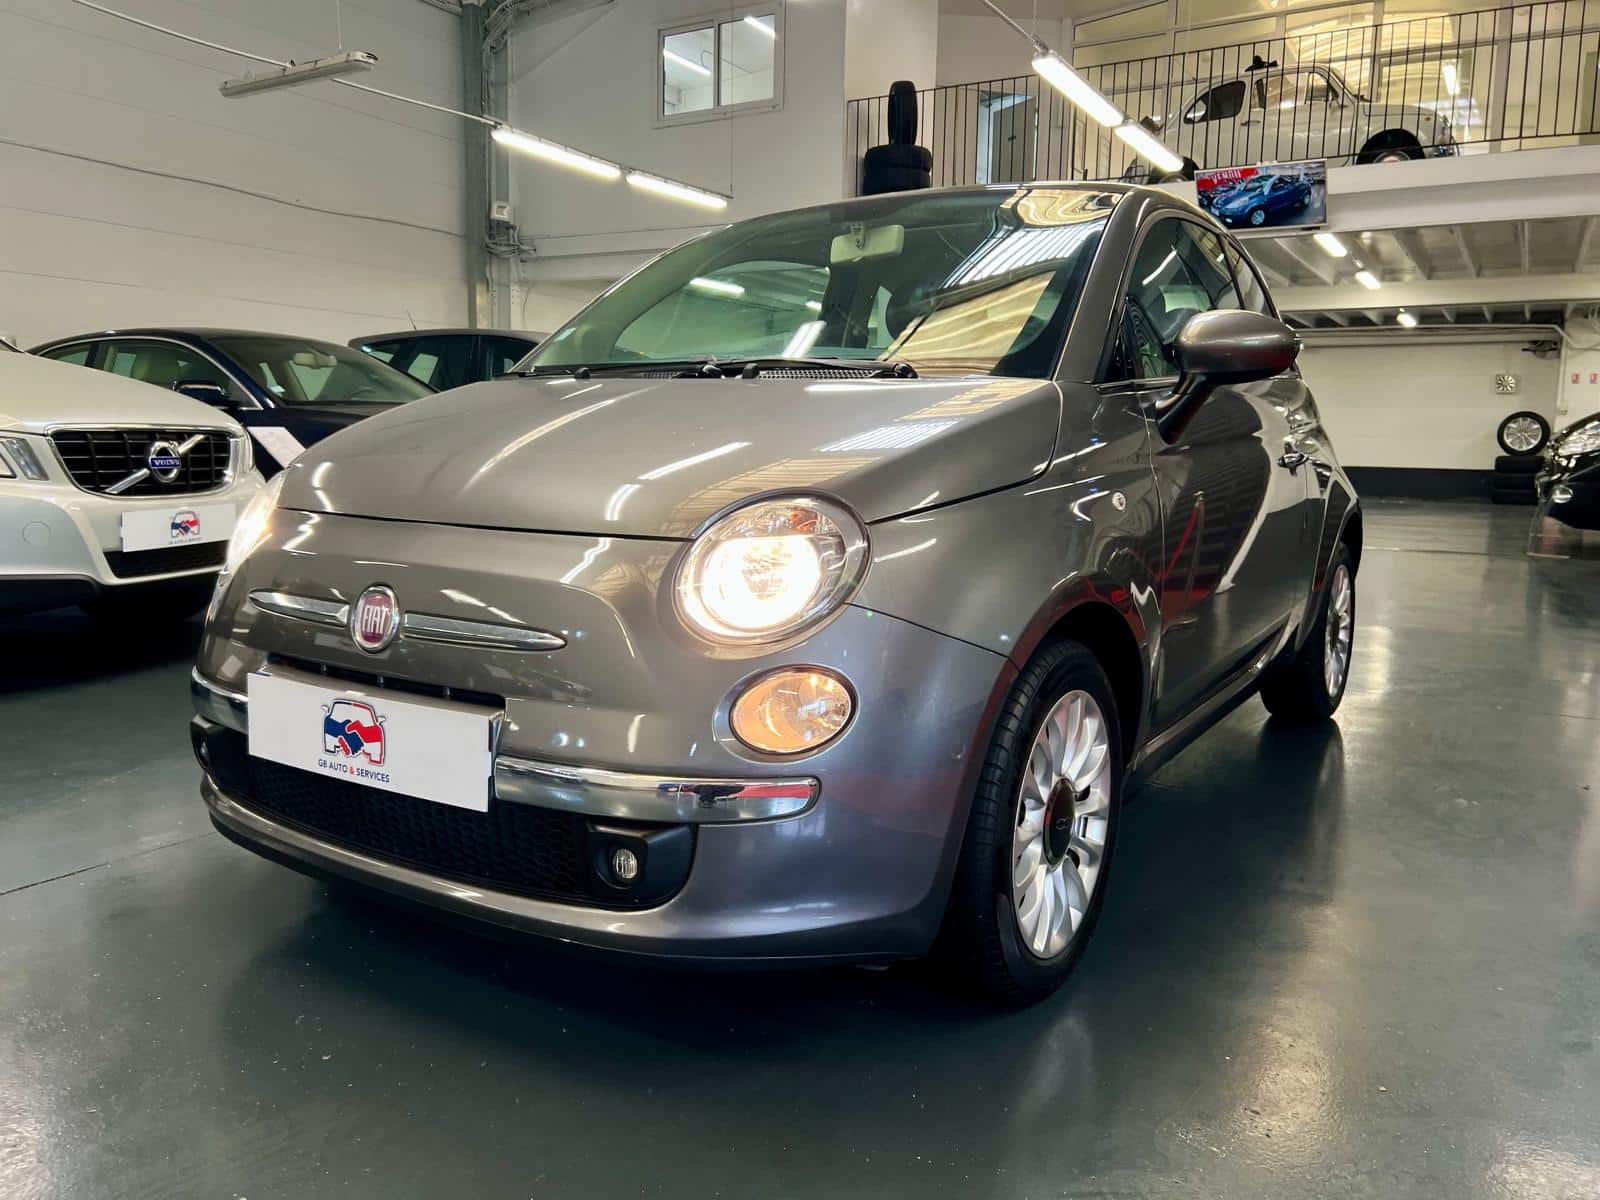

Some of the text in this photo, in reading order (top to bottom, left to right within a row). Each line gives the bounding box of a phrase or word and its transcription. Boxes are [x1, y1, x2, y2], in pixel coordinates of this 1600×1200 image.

[362, 604, 391, 635] FIAT
[318, 758, 328, 768] GB
[329, 761, 348, 773] AUTO
[356, 767, 390, 783] SERVICES
